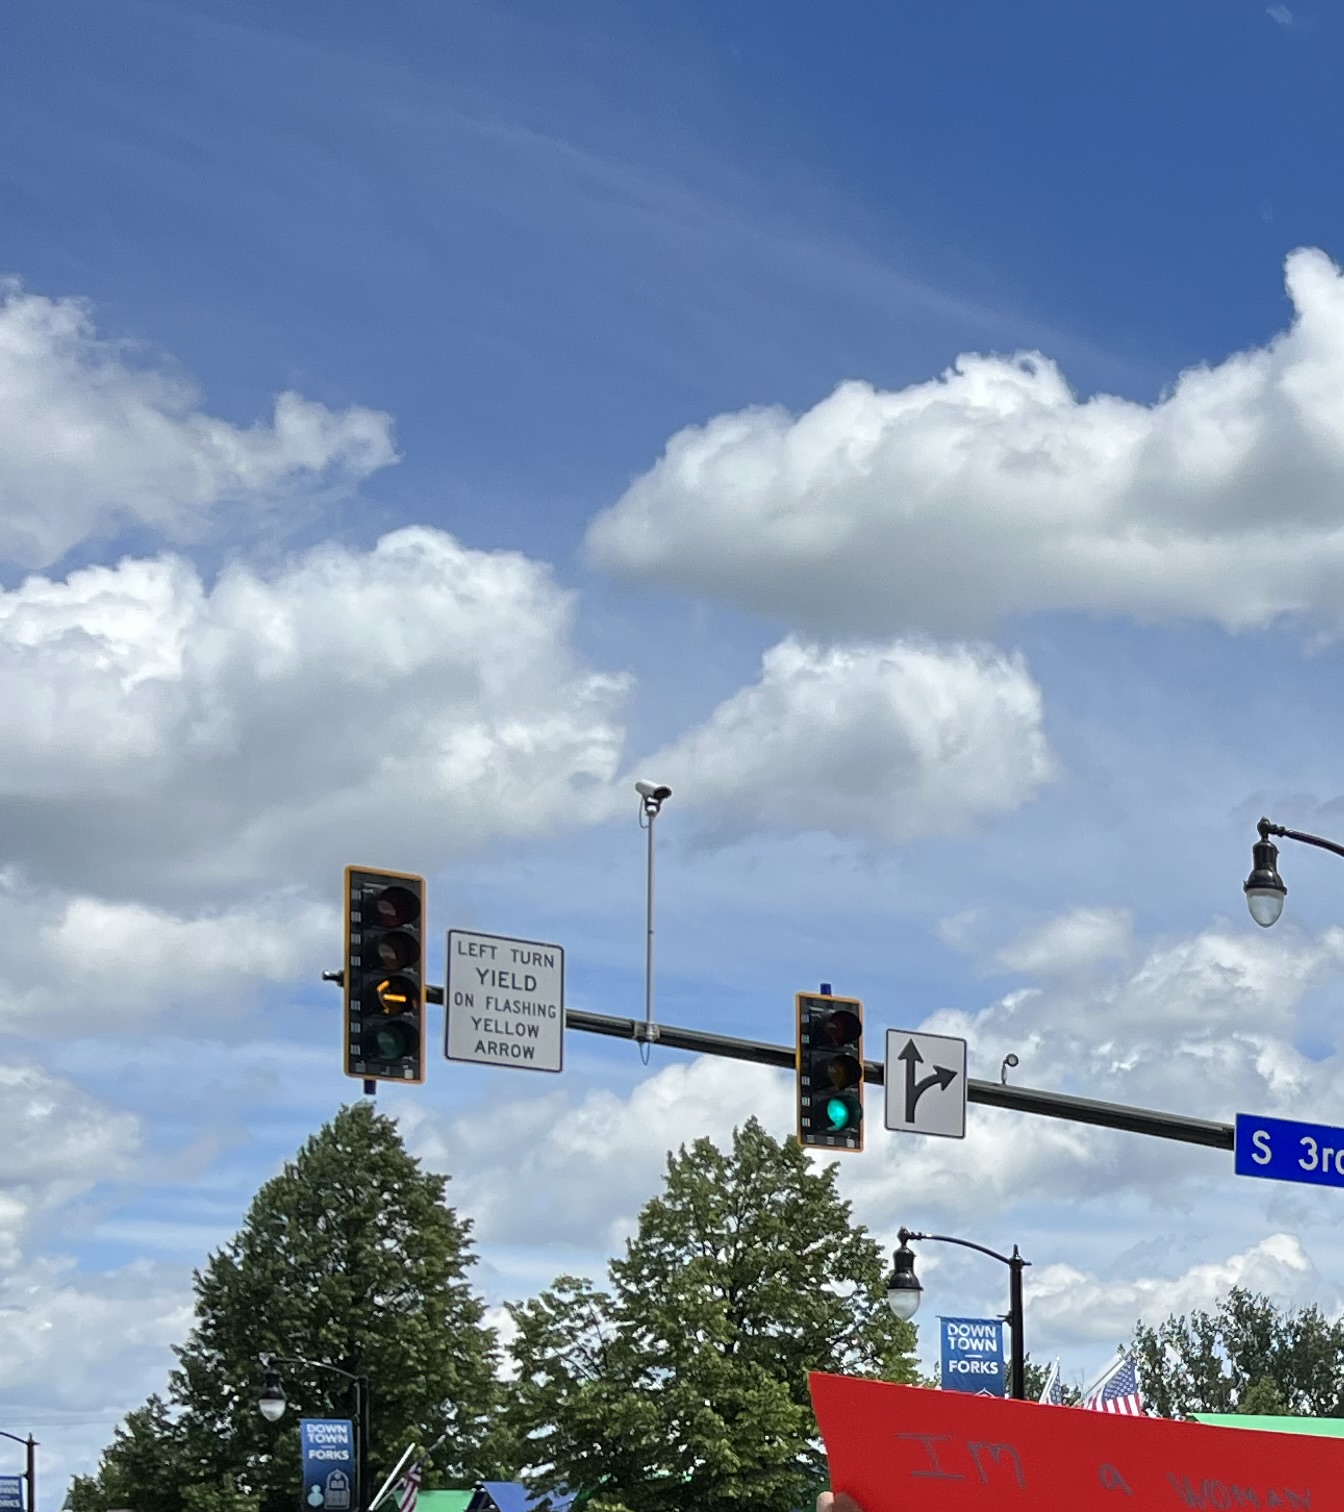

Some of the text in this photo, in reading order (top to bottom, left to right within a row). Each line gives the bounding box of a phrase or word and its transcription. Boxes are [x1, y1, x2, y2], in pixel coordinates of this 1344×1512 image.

[457, 941, 555, 969] LEFT TURN
[476, 967, 538, 992] YIELD
[454, 991, 557, 1019] ON FLASHING
[471, 1016, 540, 1039] YELLOW
[474, 1039, 535, 1060] ARROW
[1251, 1130, 1273, 1165] S
[946, 1323, 997, 1338] DOWN
[947, 1336, 998, 1352] TOWN
[948, 1360, 999, 1375] FORKS
[306, 1423, 348, 1433] DOWN
[306, 1433, 349, 1444] TOWN
[308, 1449, 350, 1461] FORKS
